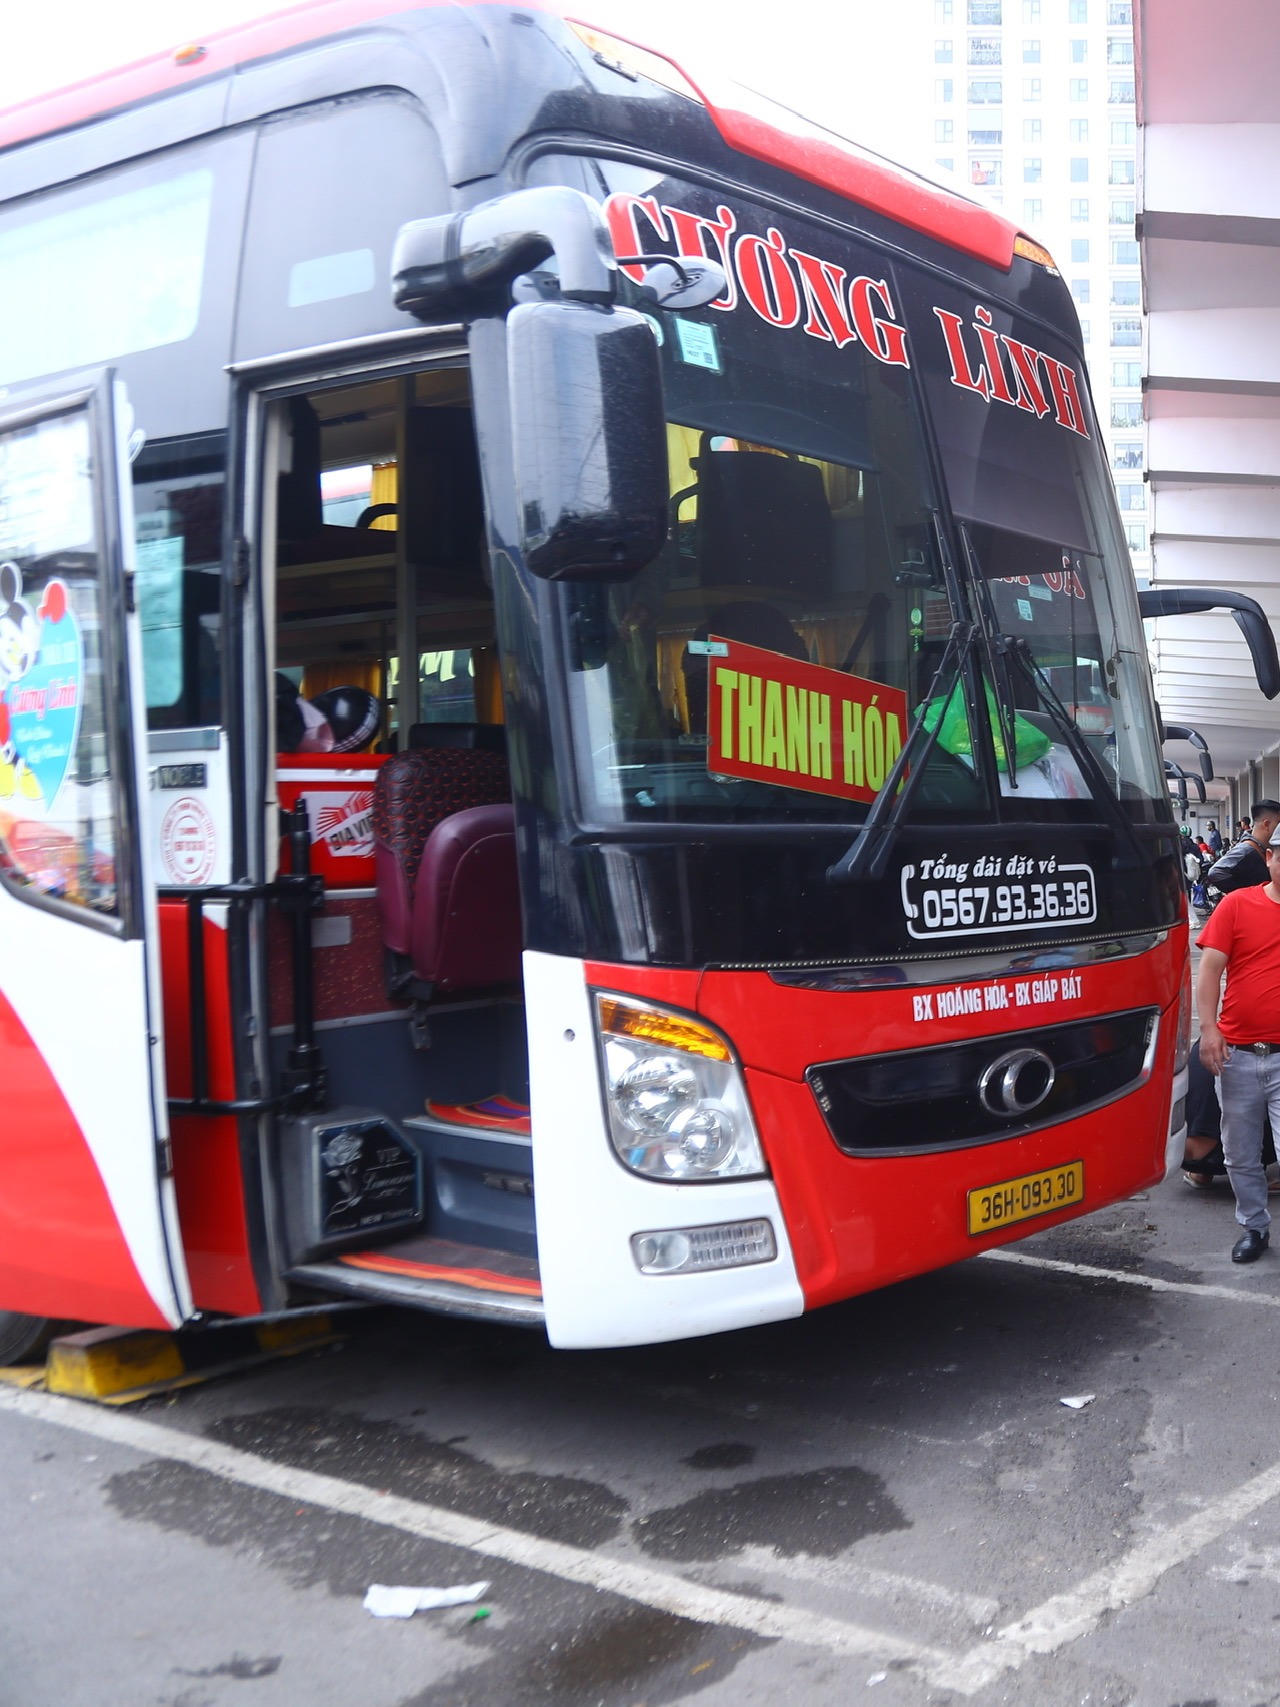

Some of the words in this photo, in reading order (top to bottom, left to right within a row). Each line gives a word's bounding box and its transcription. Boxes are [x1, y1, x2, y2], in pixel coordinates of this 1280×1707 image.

[932, 304, 1091, 440] LĨNH
[715, 666, 832, 780] THANH
[841, 695, 906, 797] HÓA
[920, 853, 969, 883] Tổng
[972, 856, 1001, 878] đài
[1006, 855, 1033, 879] đặt
[1038, 855, 1056, 874] vé
[923, 881, 1090, 928] 0567.93.36.36
[912, 994, 934, 1022] BX
[1015, 982, 1031, 1007] BX
[1031, 973, 1058, 1005] GIÁP
[1061, 969, 1082, 1001] BÁT
[981, 1170, 1075, 1223] 36H-093.30
